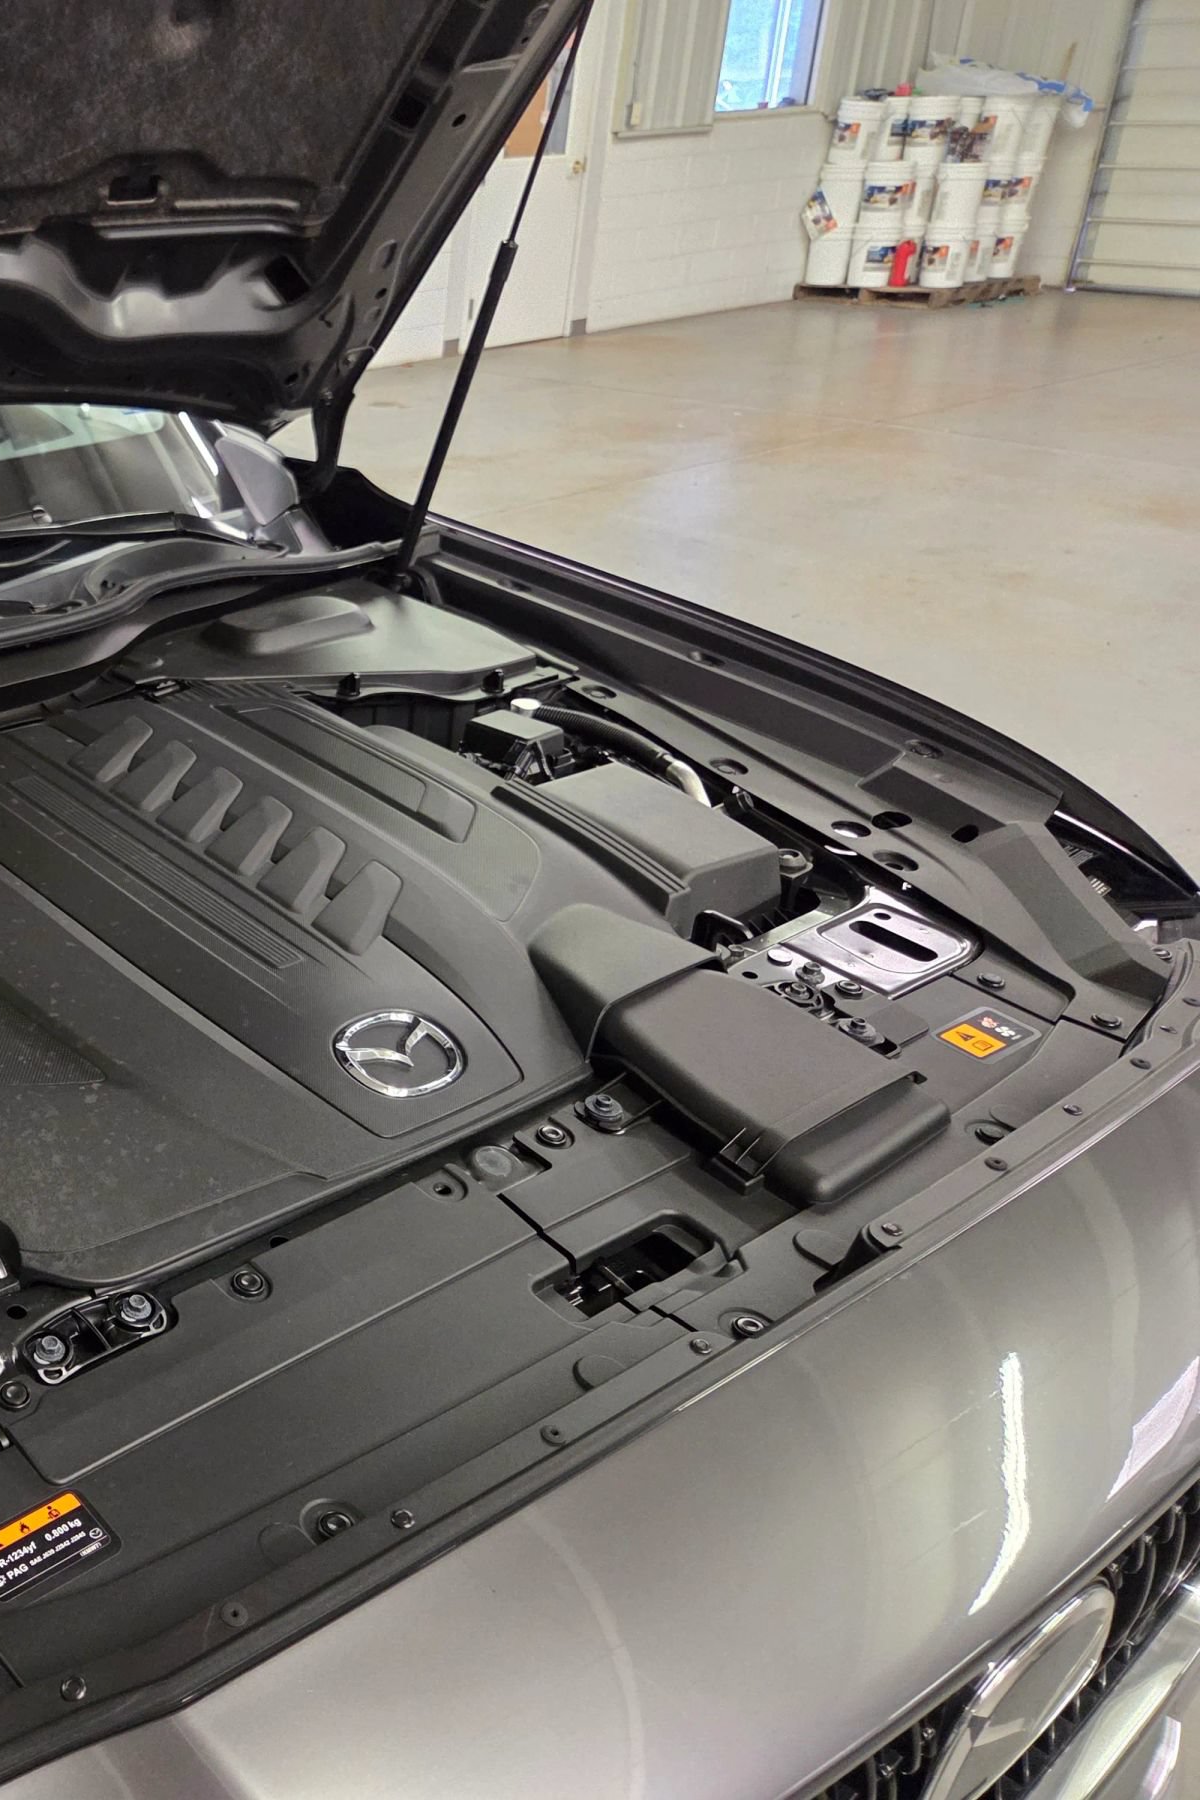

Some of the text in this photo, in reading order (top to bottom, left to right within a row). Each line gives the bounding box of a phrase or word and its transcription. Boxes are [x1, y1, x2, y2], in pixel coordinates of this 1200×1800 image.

[44, 1524, 70, 1541] 0.800
[67, 1518, 82, 1529] kg
[6, 1563, 29, 1580] PAG
